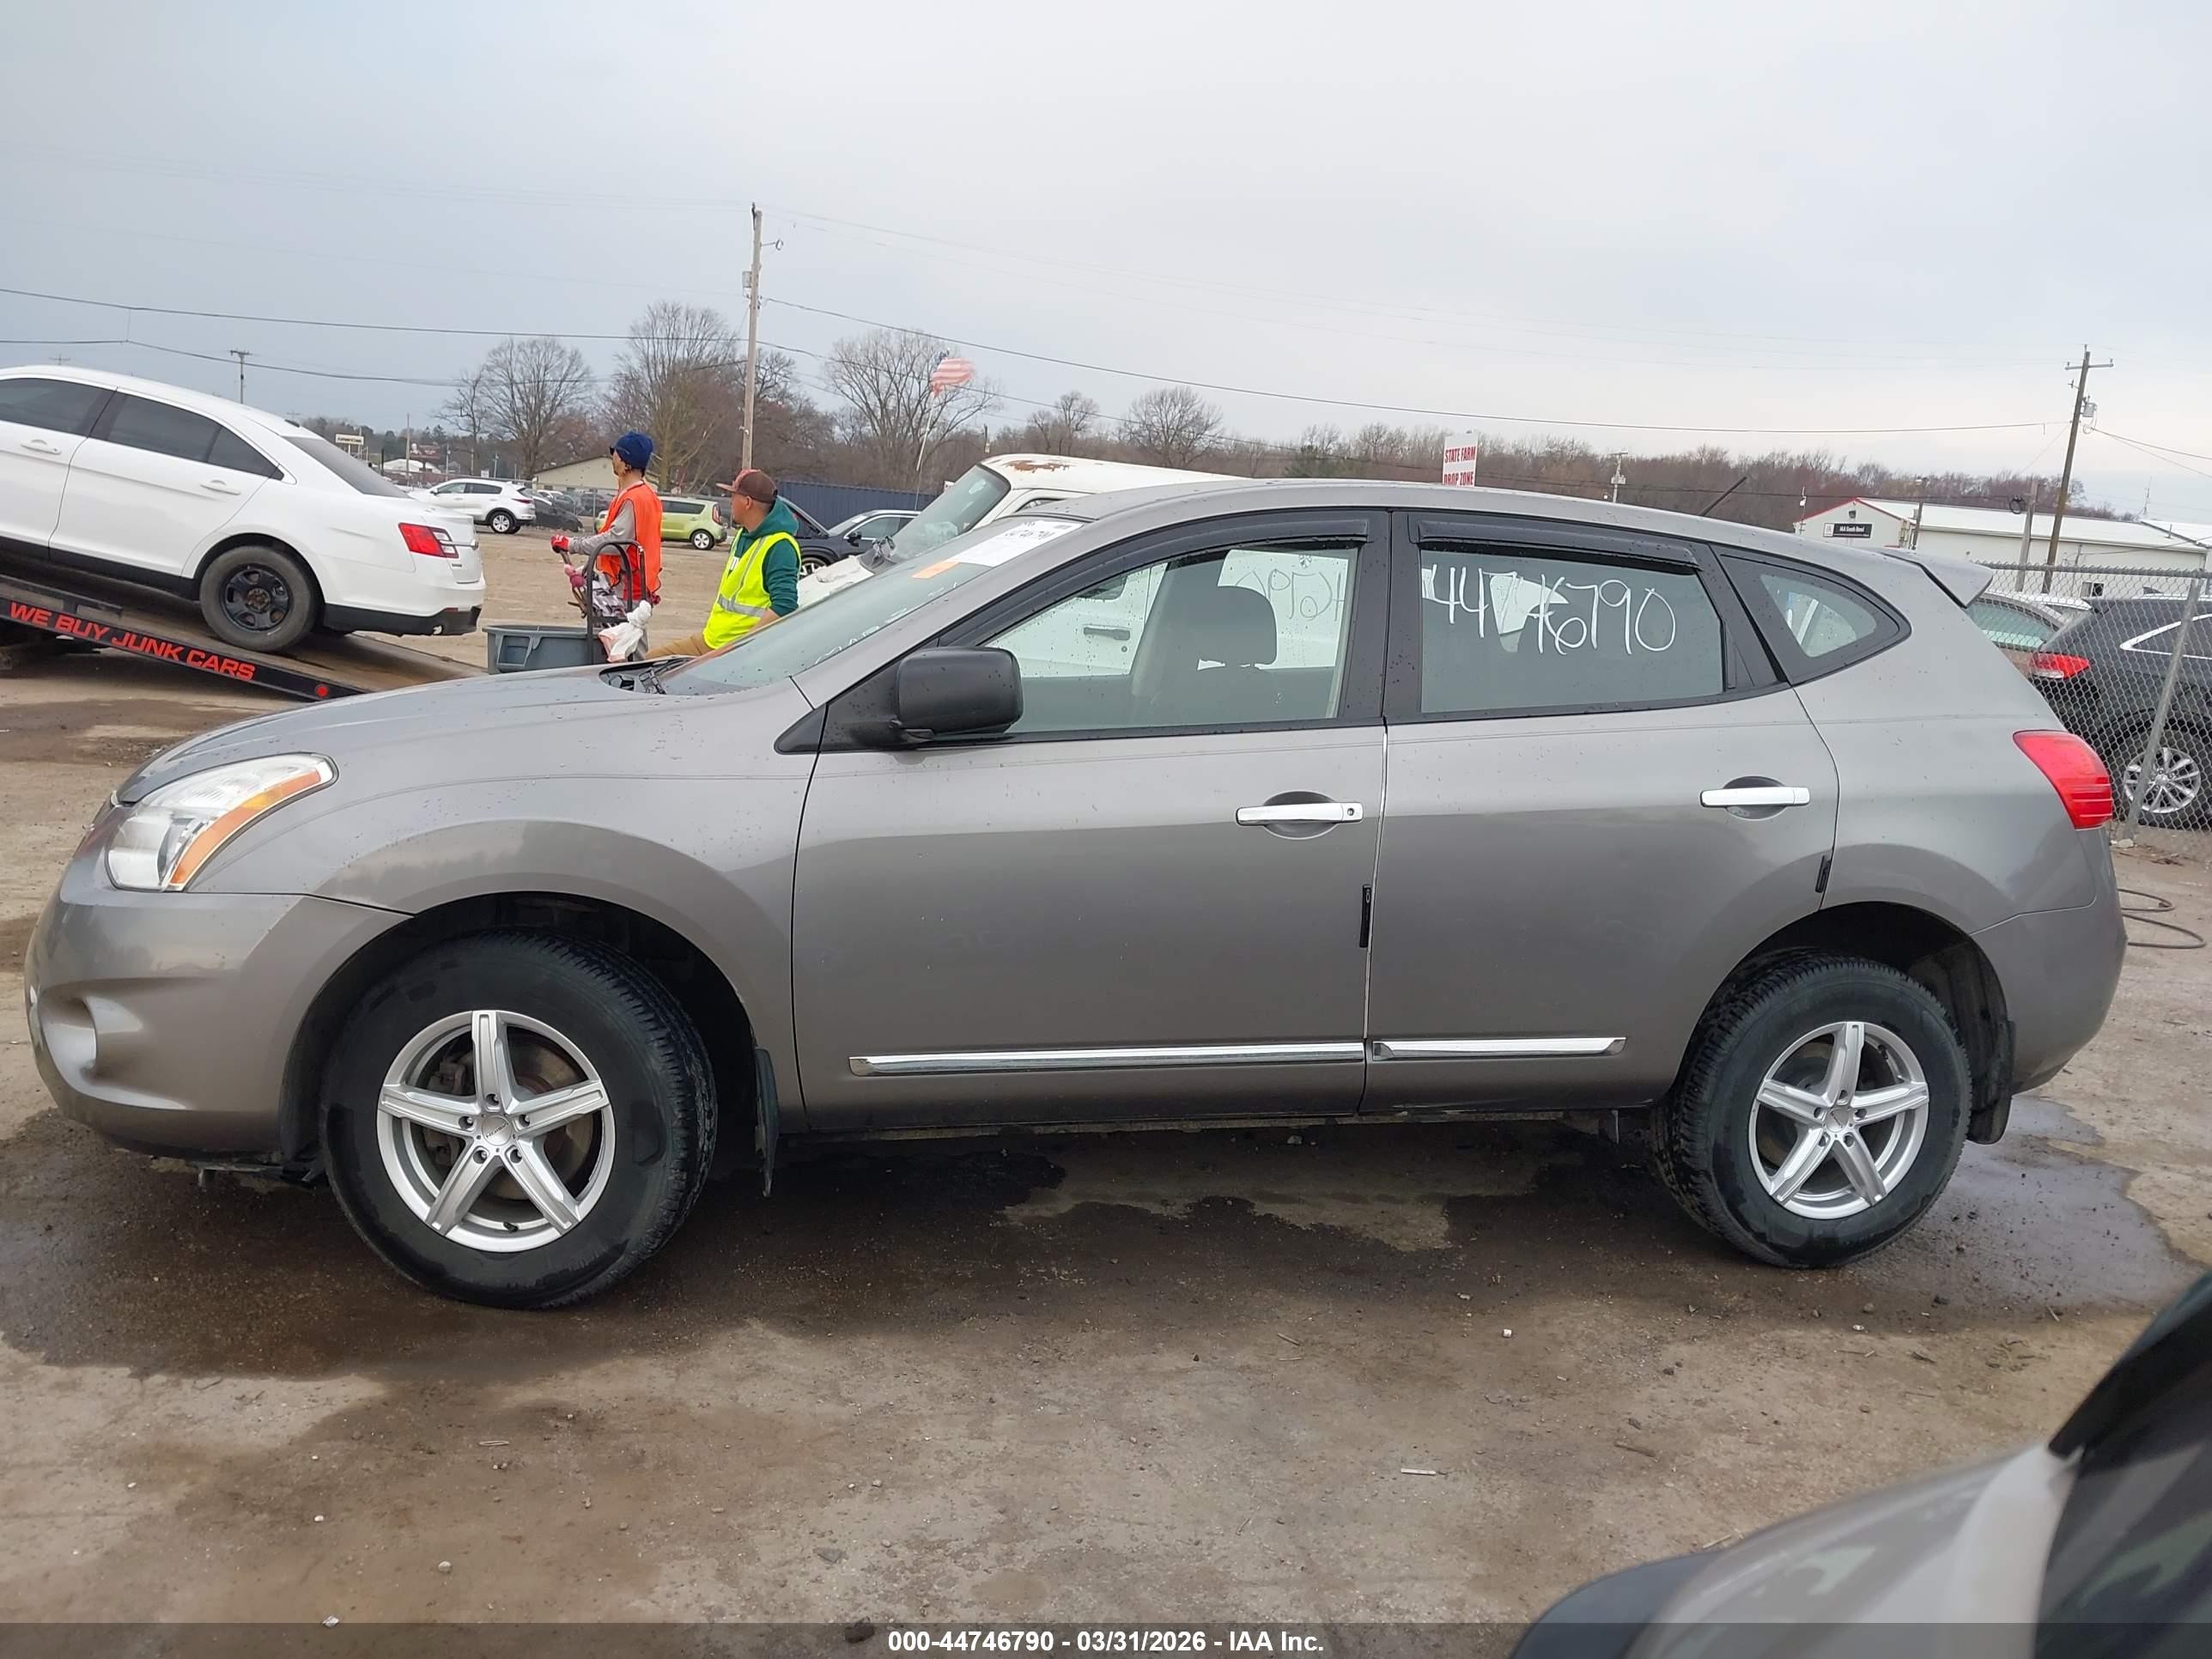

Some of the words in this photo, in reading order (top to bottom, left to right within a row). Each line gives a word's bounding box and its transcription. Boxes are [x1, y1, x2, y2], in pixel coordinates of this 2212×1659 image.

[1444, 447, 1461, 463] STATE
[1461, 447, 1476, 462] FARM
[1443, 472, 1459, 486] DROP
[1460, 471, 1474, 486] ZONE
[9, 602, 52, 626] WE
[54, 614, 110, 641] BUY
[112, 631, 185, 661] JUNK
[187, 651, 257, 682] CARS
